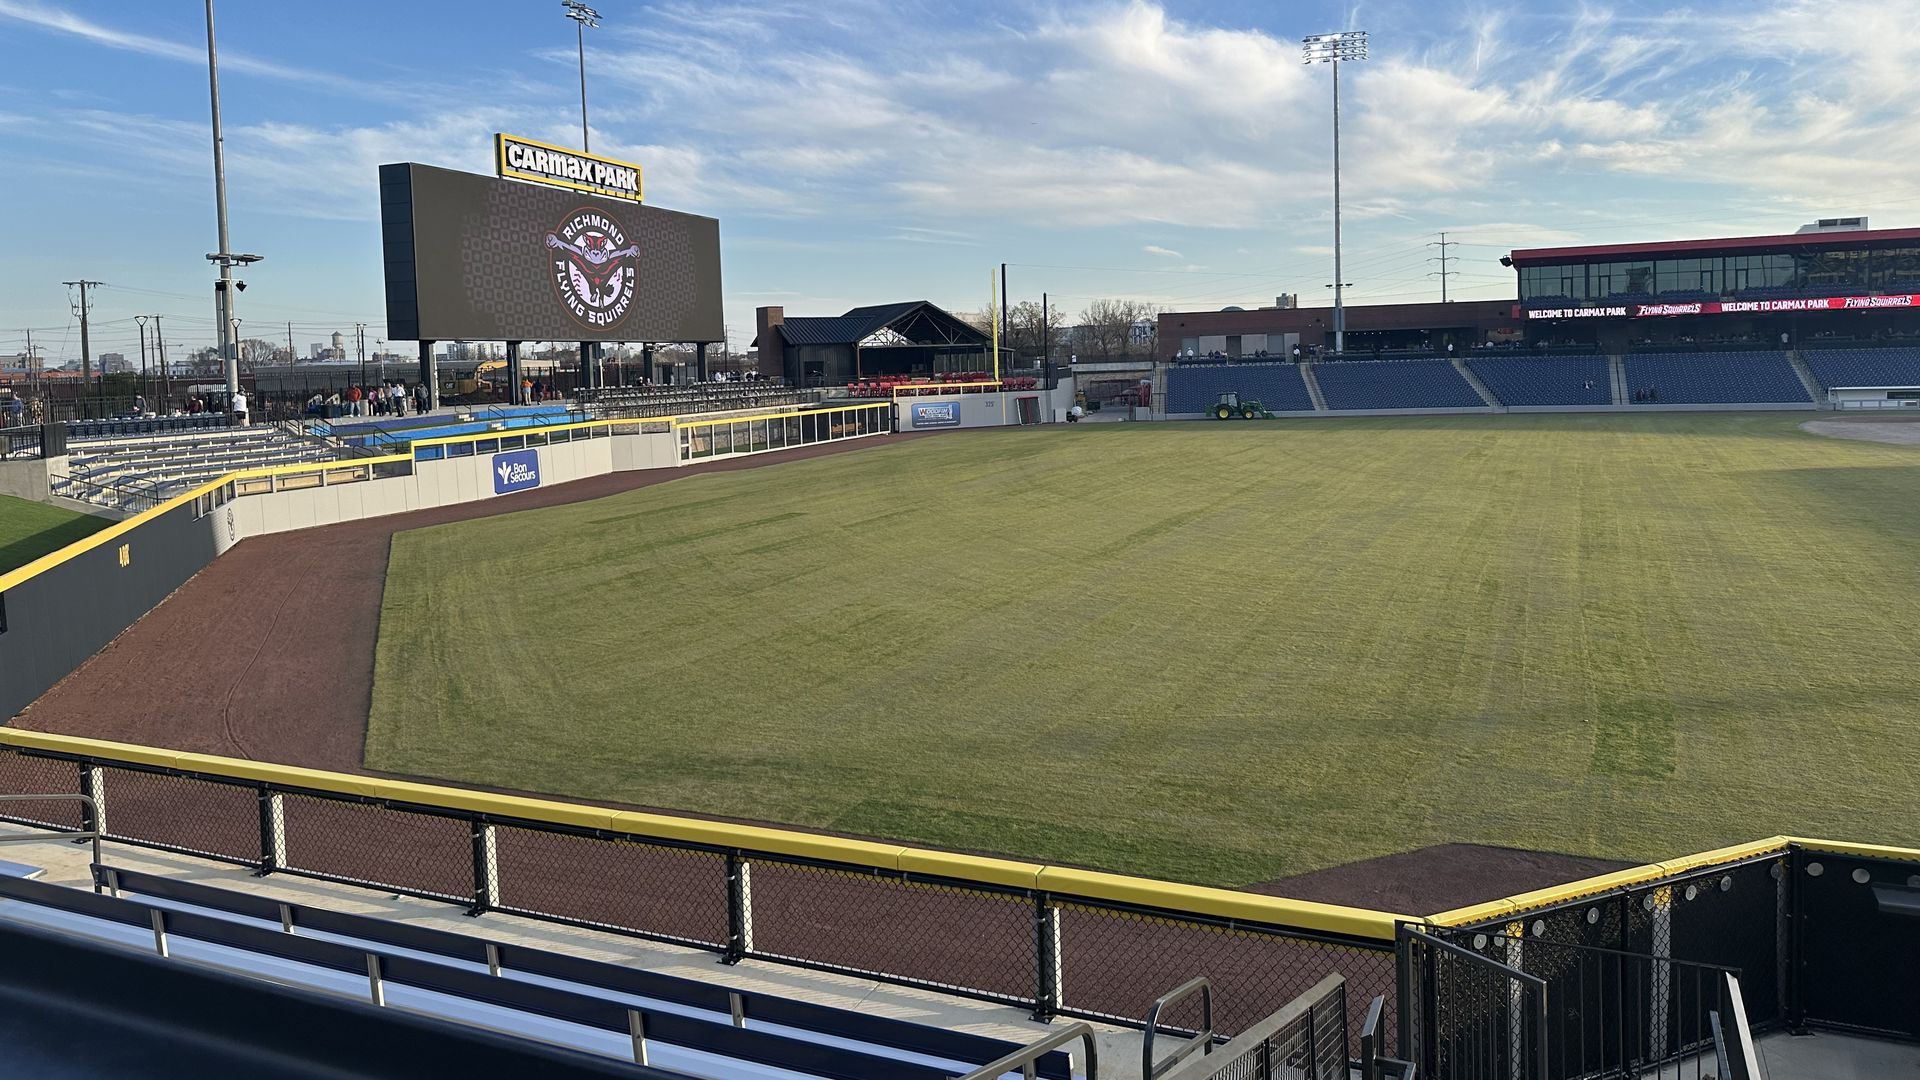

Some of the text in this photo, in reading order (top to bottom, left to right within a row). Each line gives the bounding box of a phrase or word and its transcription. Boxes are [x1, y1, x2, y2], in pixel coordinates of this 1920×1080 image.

[595, 164, 638, 191] PARK
[562, 215, 624, 245] RICHMOND
[555, 260, 634, 326] FLYING SQUIRRELS
[1721, 299, 1829, 311] WELCOME TO CARMAX PARK
[1528, 307, 1626, 319] WELCOME TO CARMAX PARK
[513, 463, 527, 473] Bon
[510, 470, 536, 484] Secours
